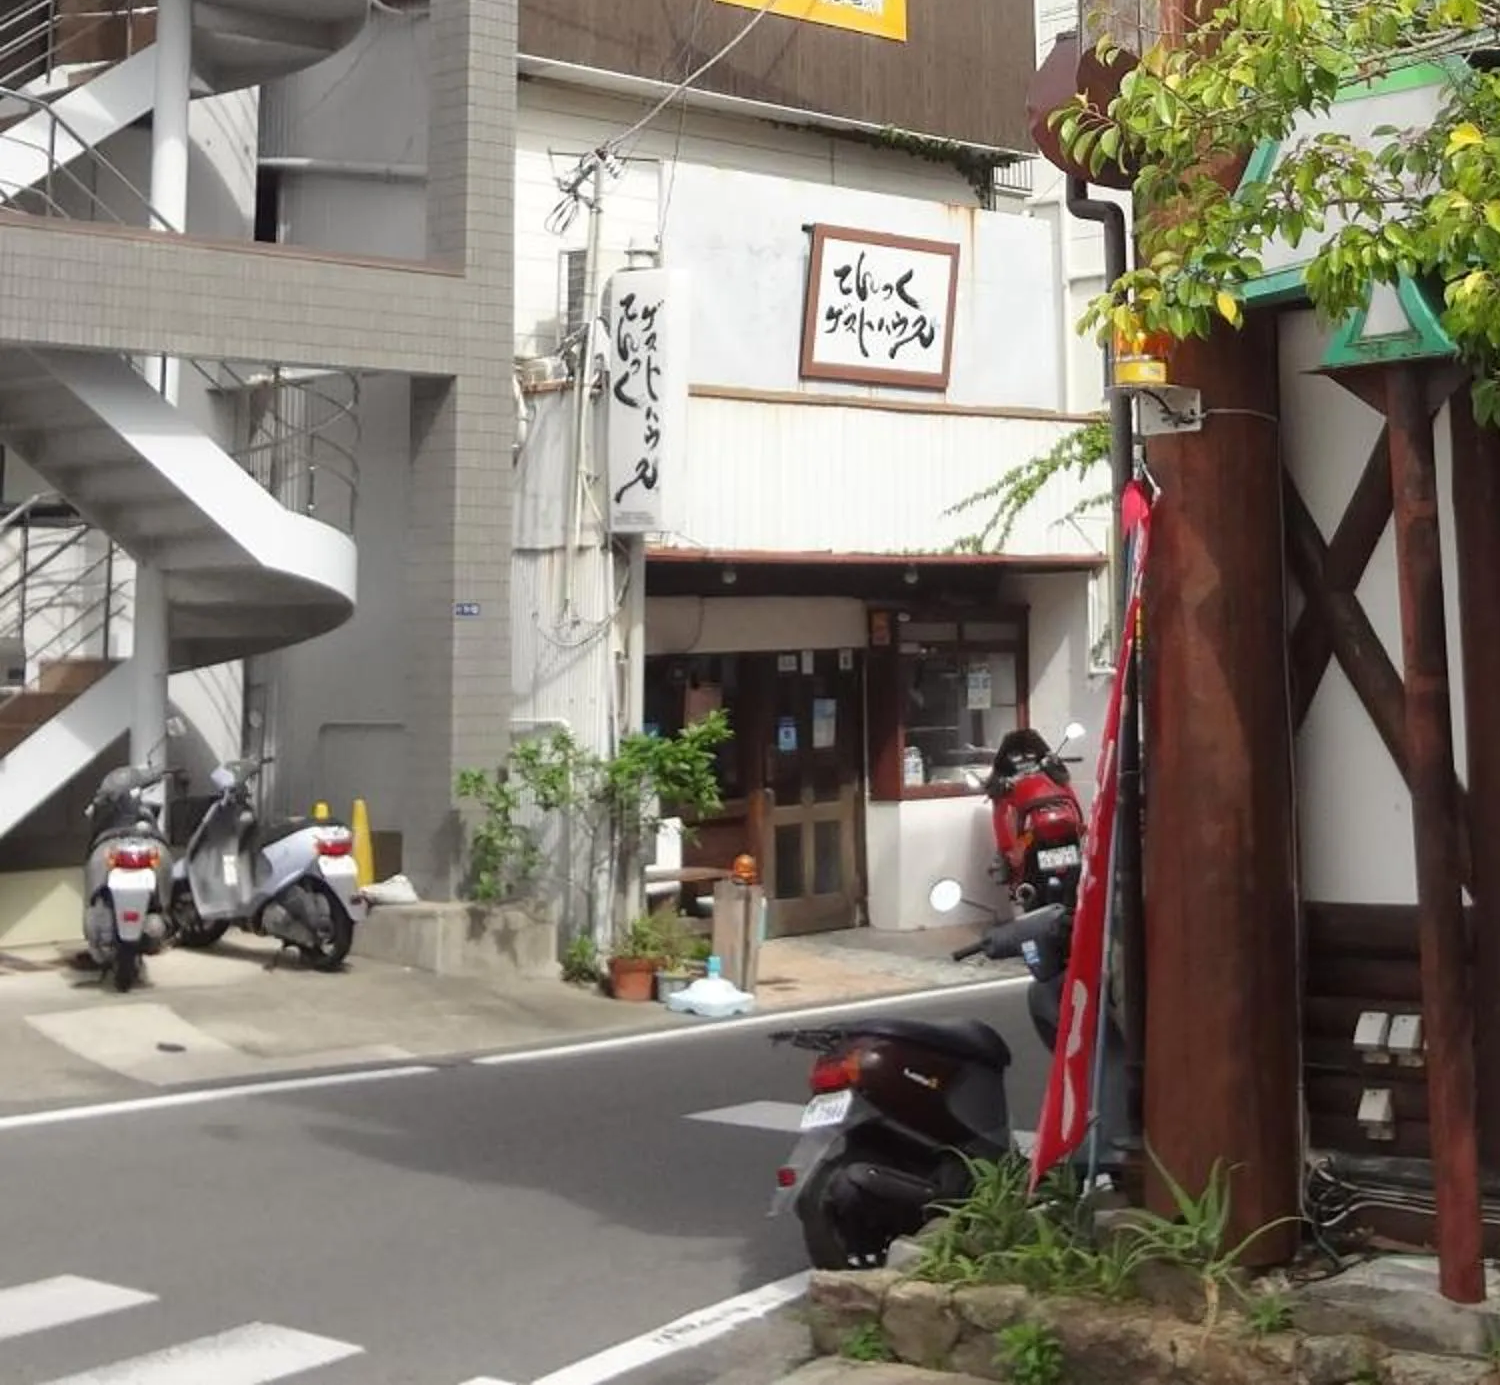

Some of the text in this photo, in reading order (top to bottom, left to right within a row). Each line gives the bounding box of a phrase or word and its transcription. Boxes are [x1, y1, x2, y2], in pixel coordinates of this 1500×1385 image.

[824, 303, 935, 359] ゲストハウス
